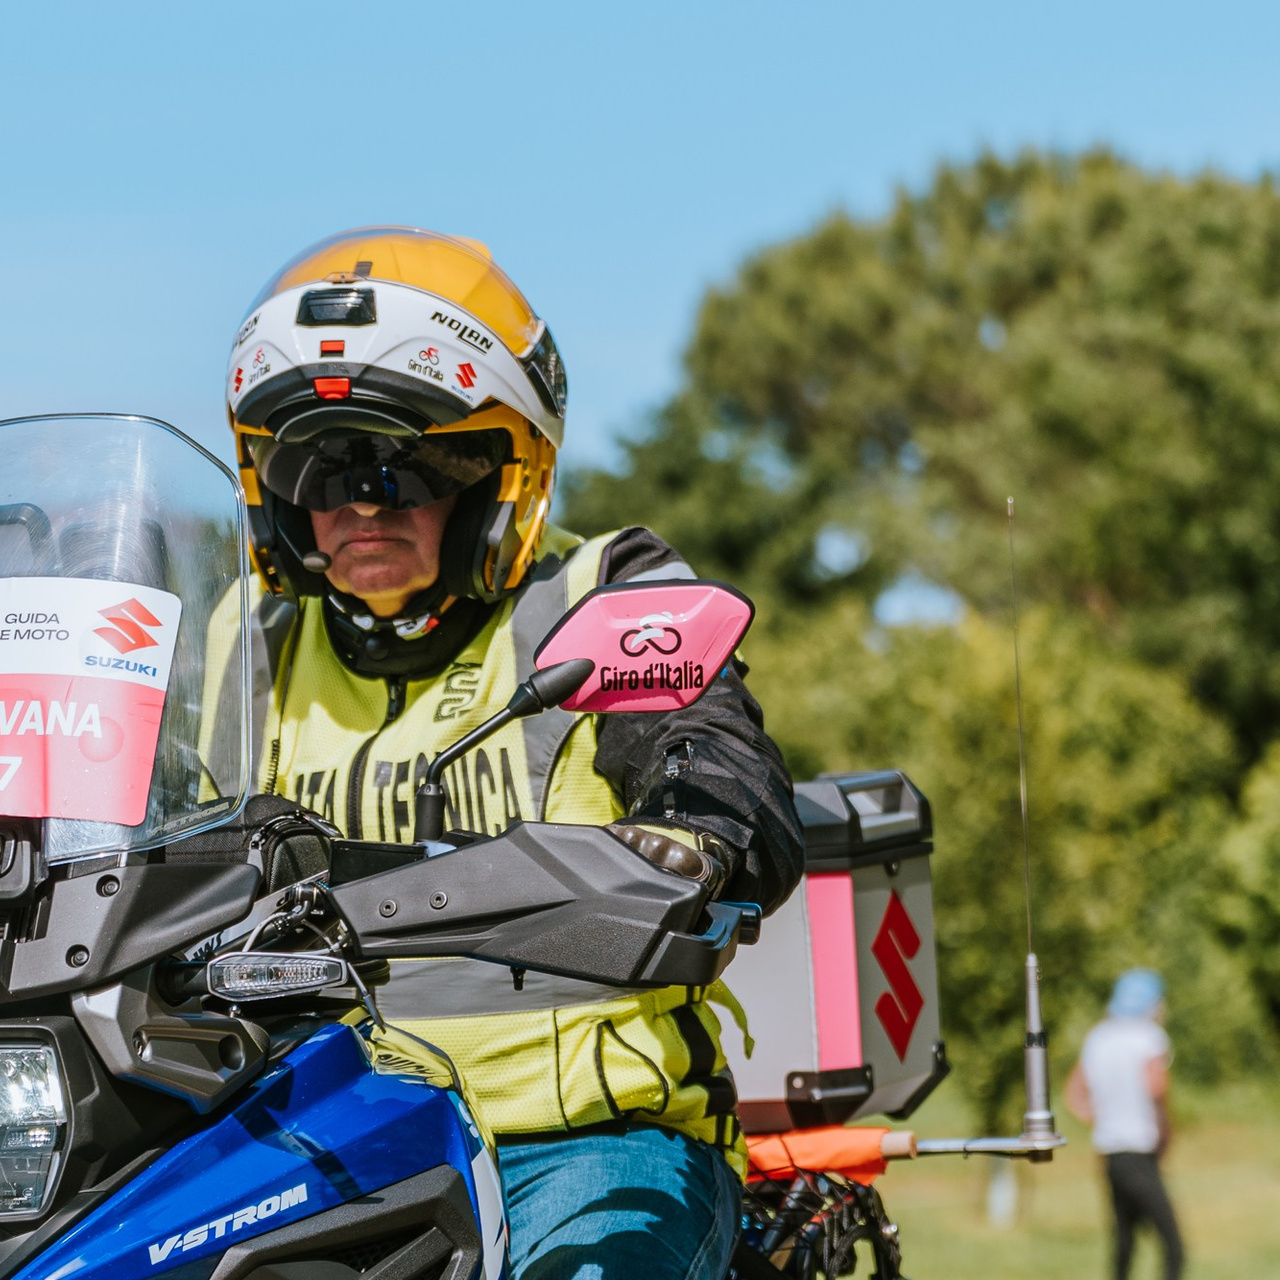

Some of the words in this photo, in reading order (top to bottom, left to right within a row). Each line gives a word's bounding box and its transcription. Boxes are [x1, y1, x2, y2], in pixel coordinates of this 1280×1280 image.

[430, 311, 493, 354] NOLAN
[4, 613, 60, 624] GUIDA
[13, 629, 70, 641] MOTO
[85, 655, 158, 677] SUZUKI
[600, 666, 639, 691] Giro
[643, 660, 704, 690] d'Italia
[148, 1183, 308, 1266] V-STROM
